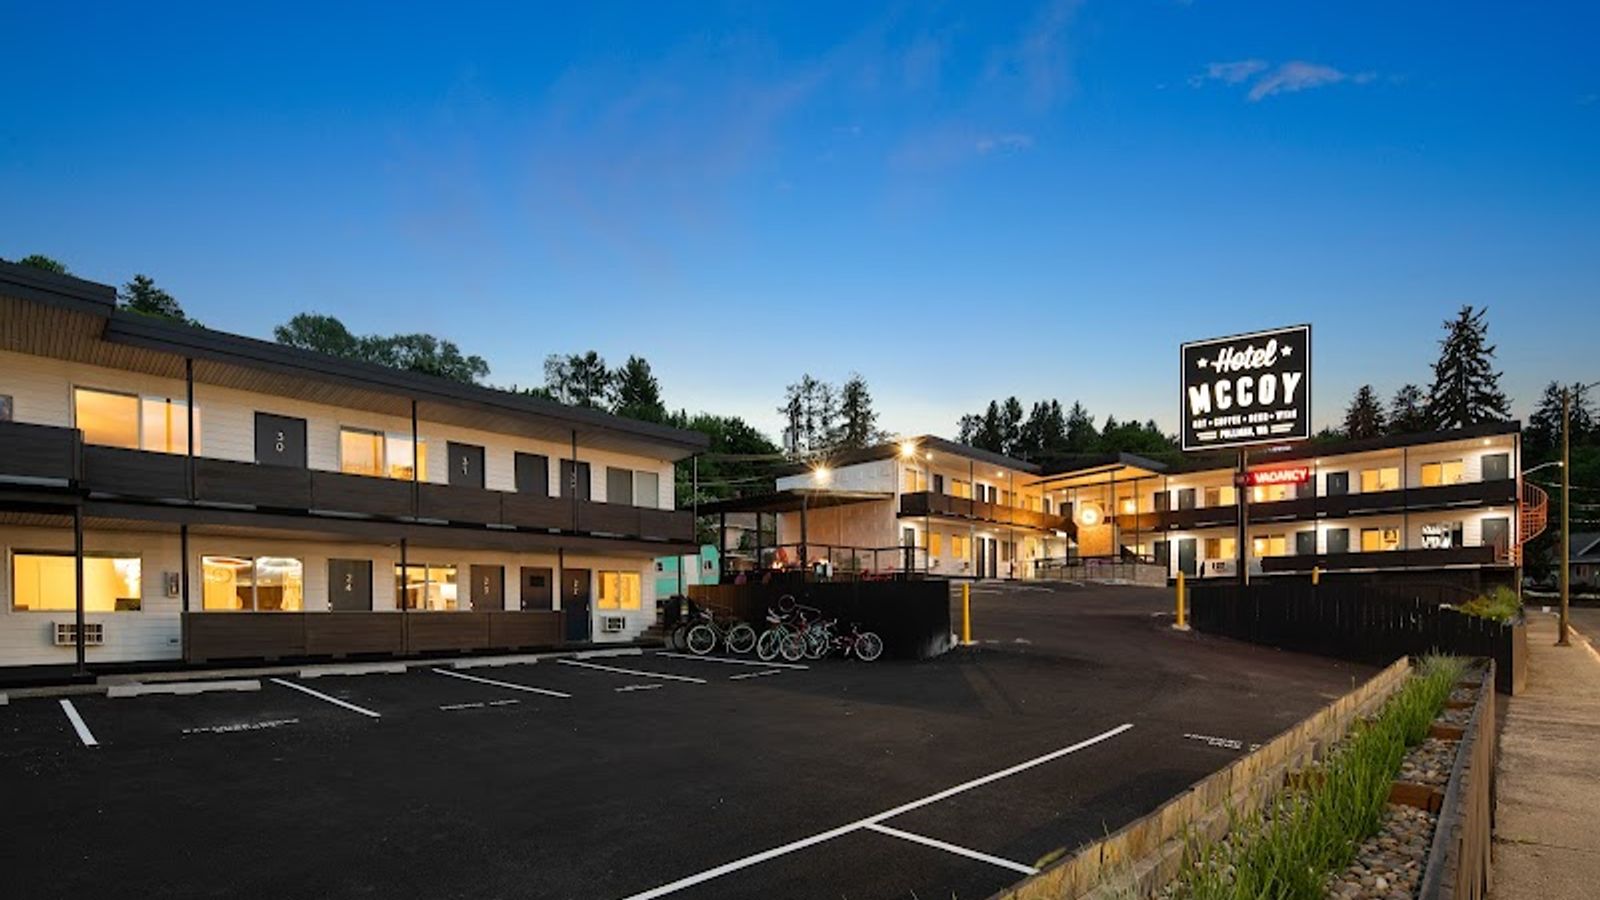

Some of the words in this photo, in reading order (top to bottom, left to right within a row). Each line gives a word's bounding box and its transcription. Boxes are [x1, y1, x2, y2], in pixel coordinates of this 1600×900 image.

[1210, 338, 1278, 374] Hotel
[1188, 372, 1303, 416] MCCOY
[1254, 467, 1308, 483] VACANCY
